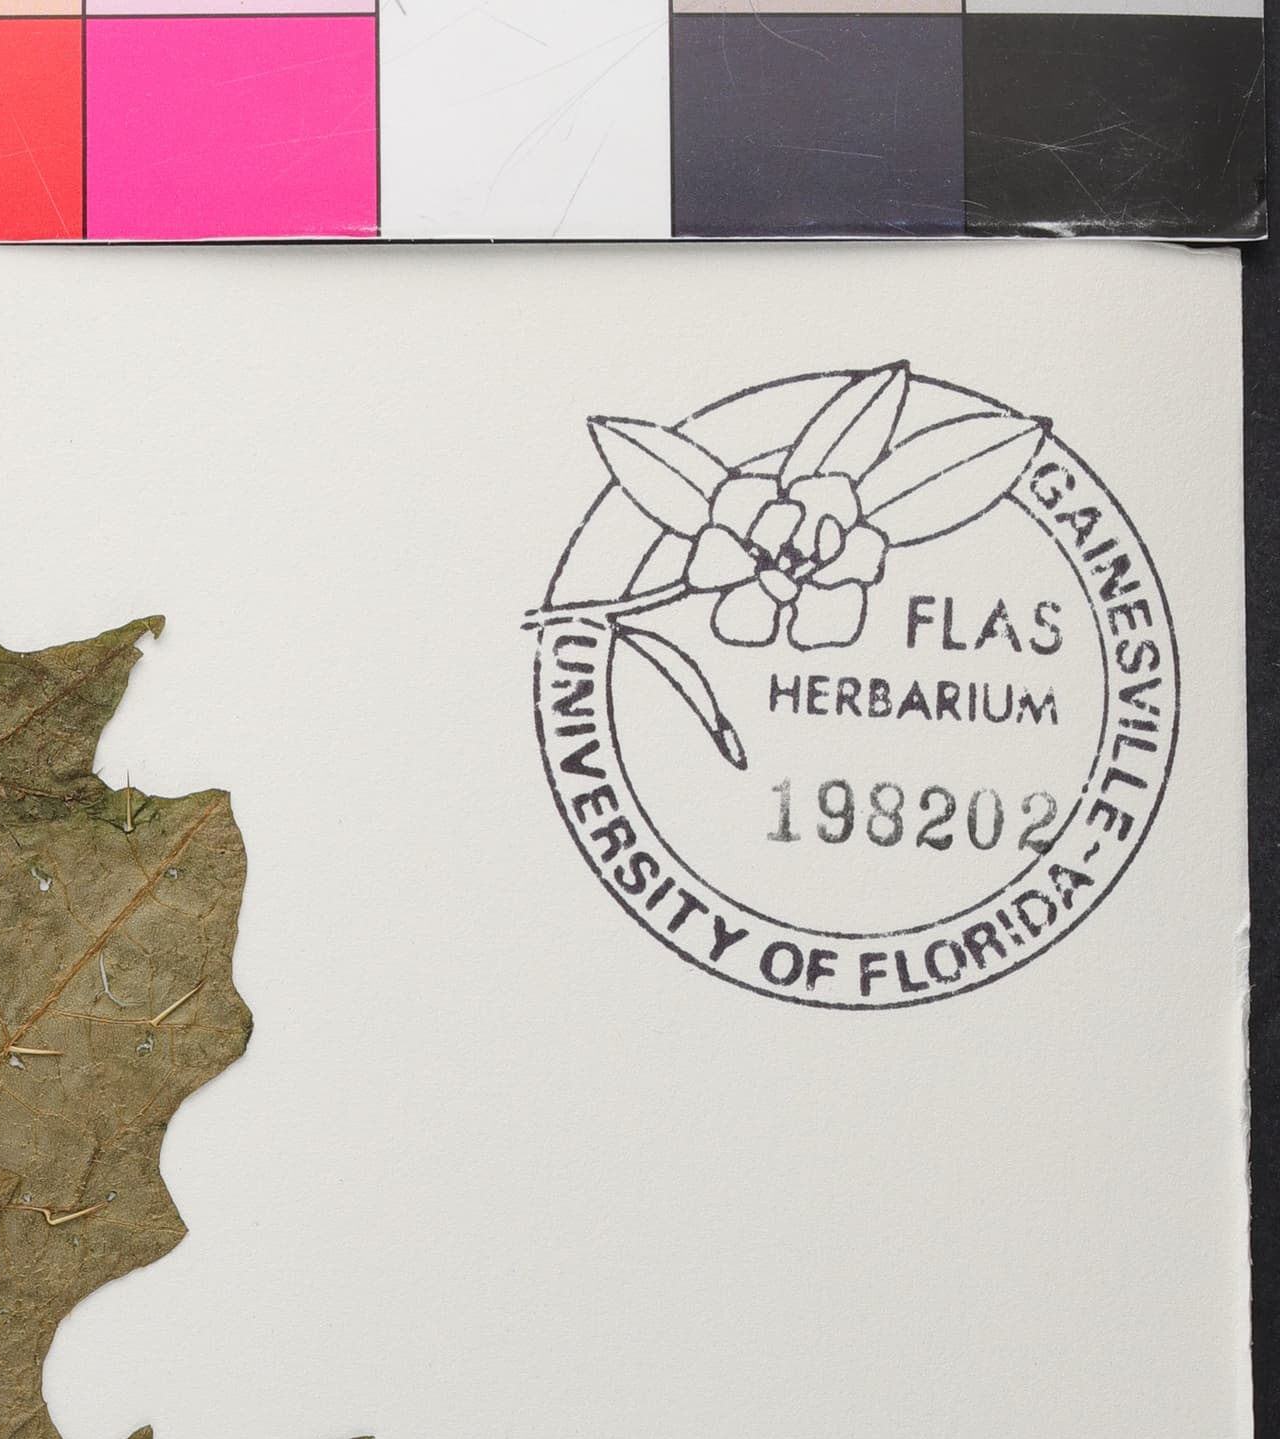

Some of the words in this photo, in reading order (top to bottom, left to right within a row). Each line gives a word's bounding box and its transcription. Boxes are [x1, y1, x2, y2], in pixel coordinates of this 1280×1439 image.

[906, 595, 1063, 656] FLAS
[769, 673, 1058, 725] HERBARIUM
[546, 632, 750, 964] UNIVERSITY
[758, 938, 842, 992] OF
[857, 860, 1095, 998] FLORIDA
[767, 778, 1060, 855] 198202
